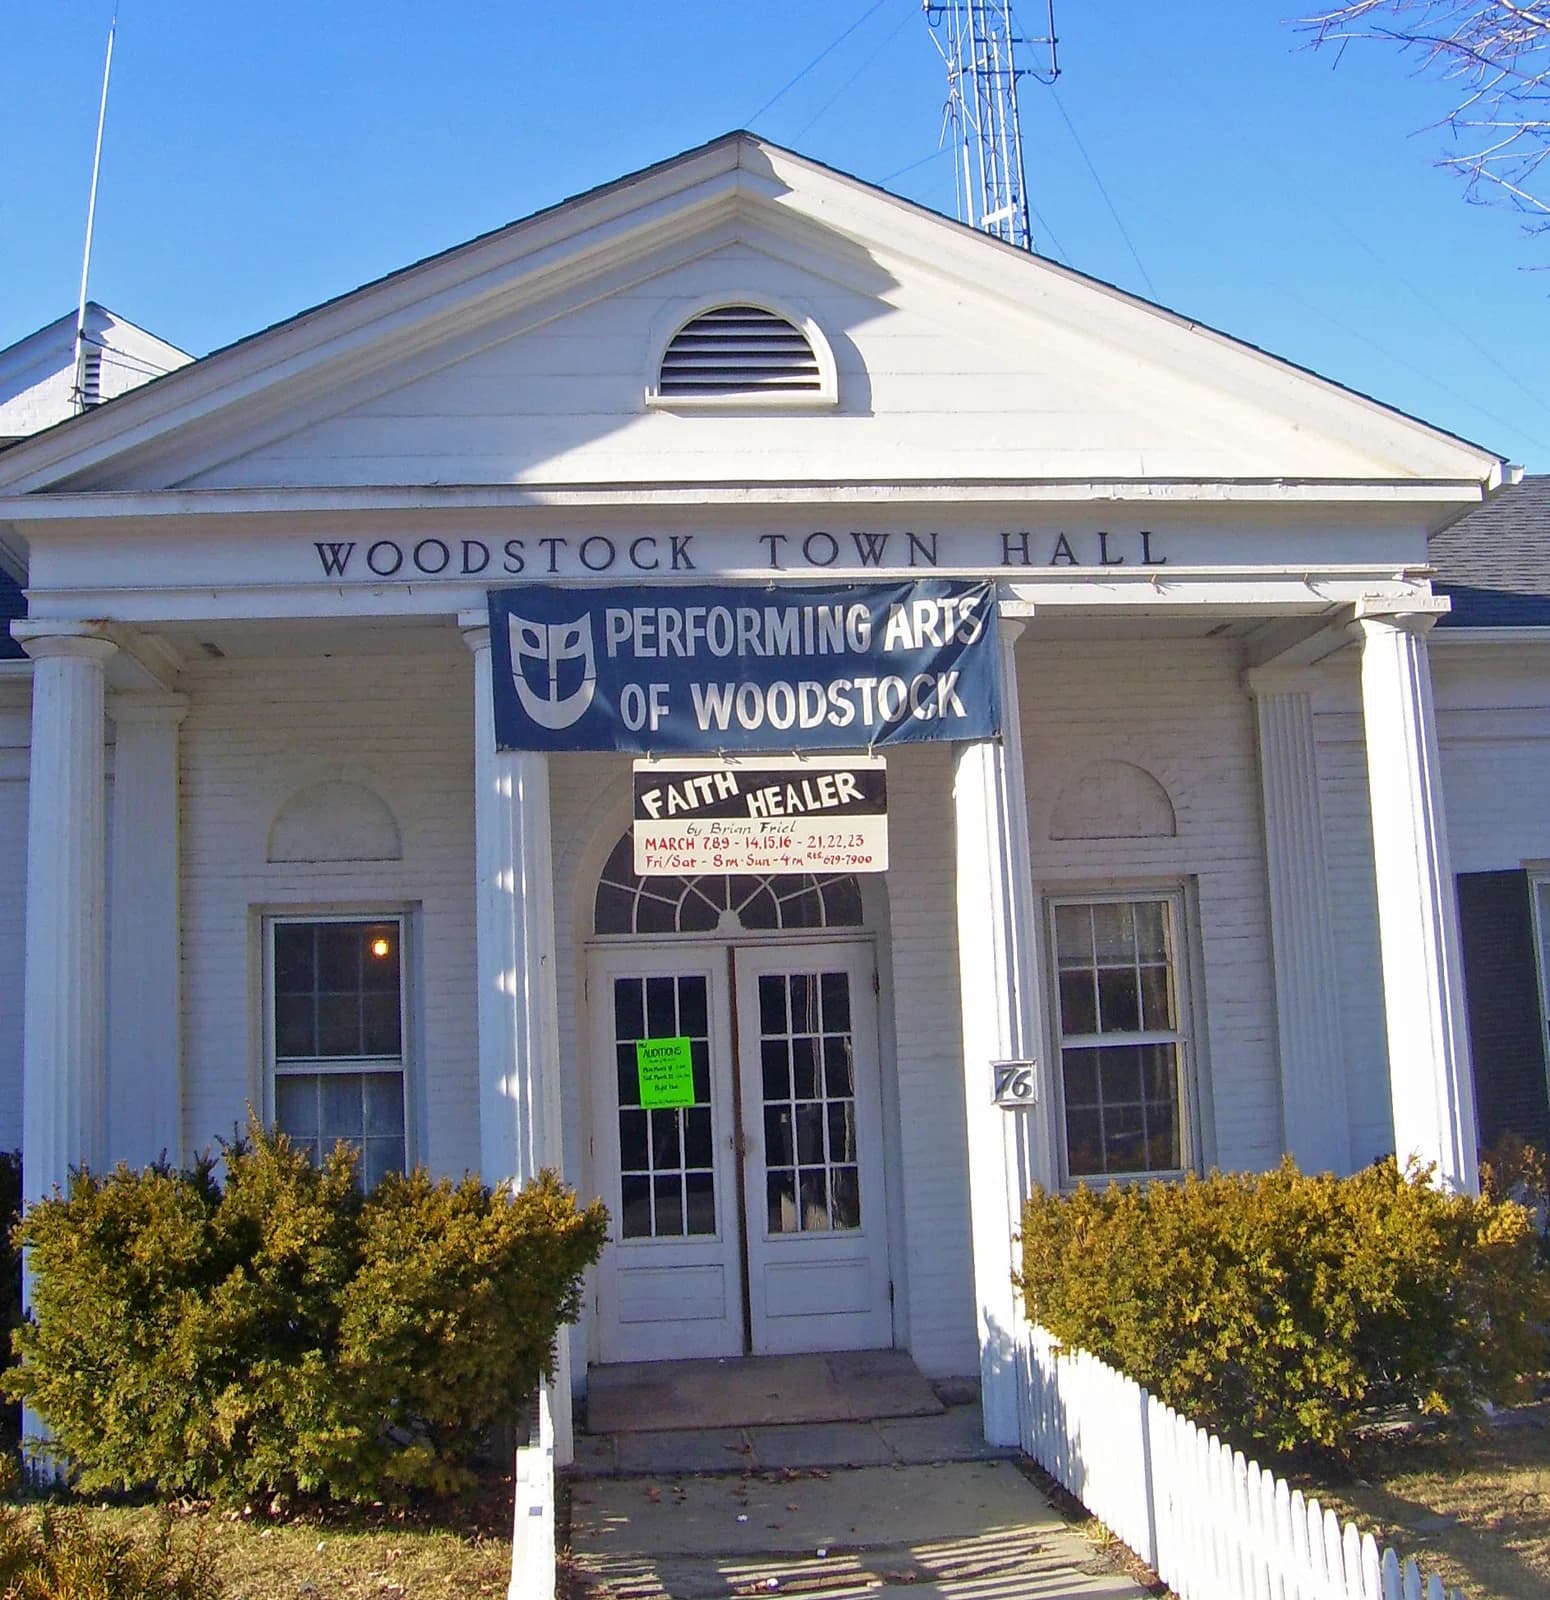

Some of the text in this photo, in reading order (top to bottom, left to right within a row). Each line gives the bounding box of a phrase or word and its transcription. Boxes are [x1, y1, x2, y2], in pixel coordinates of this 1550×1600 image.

[313, 531, 1168, 577] WOODSTOCK TOWN HALL
[605, 597, 983, 657] PERFORMING ARTS
[619, 671, 968, 732] OF WOODSTOCK
[641, 770, 866, 819] FAITH HEALER
[645, 837, 695, 851] MARCH
[686, 820, 797, 837] by Brian Friel
[645, 853, 697, 869] Fri/Sat
[996, 1067, 1032, 1099] 76
